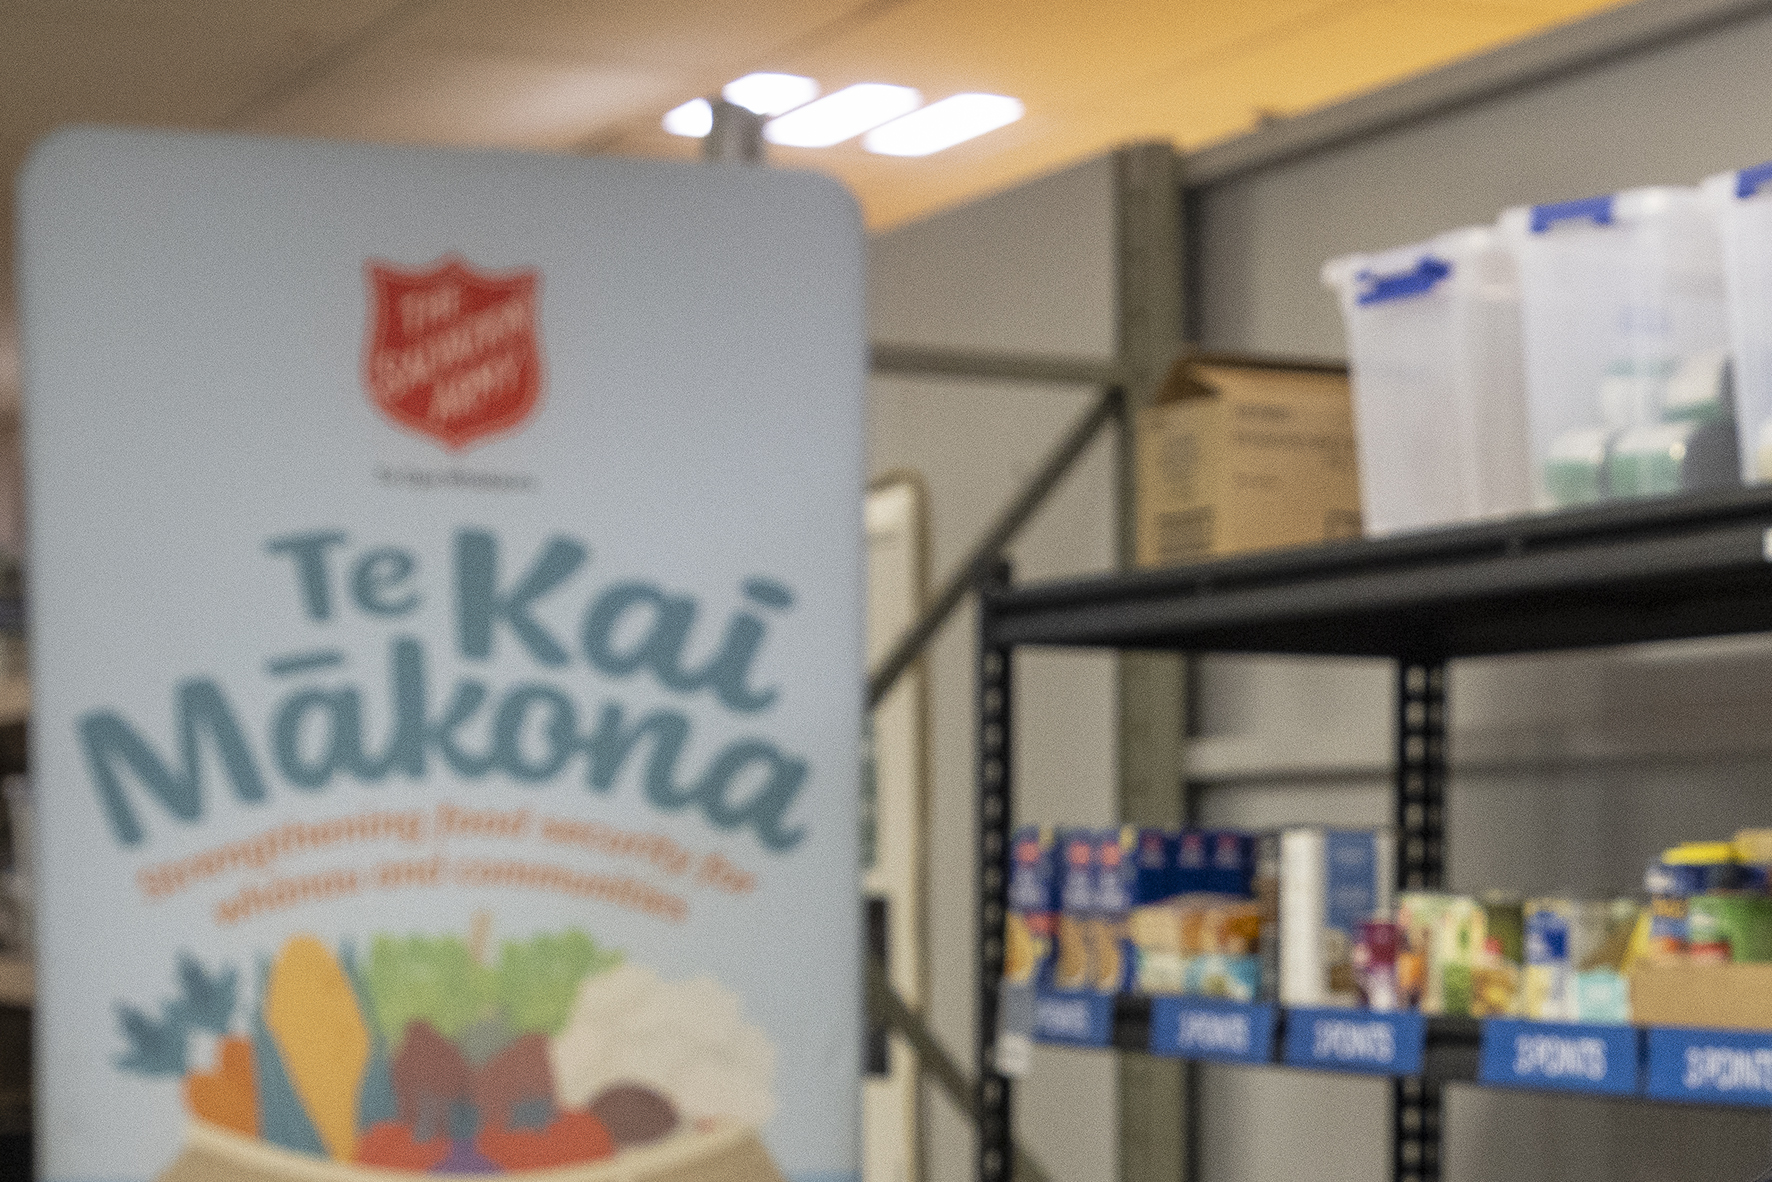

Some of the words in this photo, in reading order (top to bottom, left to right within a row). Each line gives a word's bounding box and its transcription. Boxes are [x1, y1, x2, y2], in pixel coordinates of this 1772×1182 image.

[264, 529, 422, 622] Te
[452, 526, 795, 713] Kai
[74, 635, 809, 854] Mākona
[1533, 1036, 1606, 1080] POINTS
